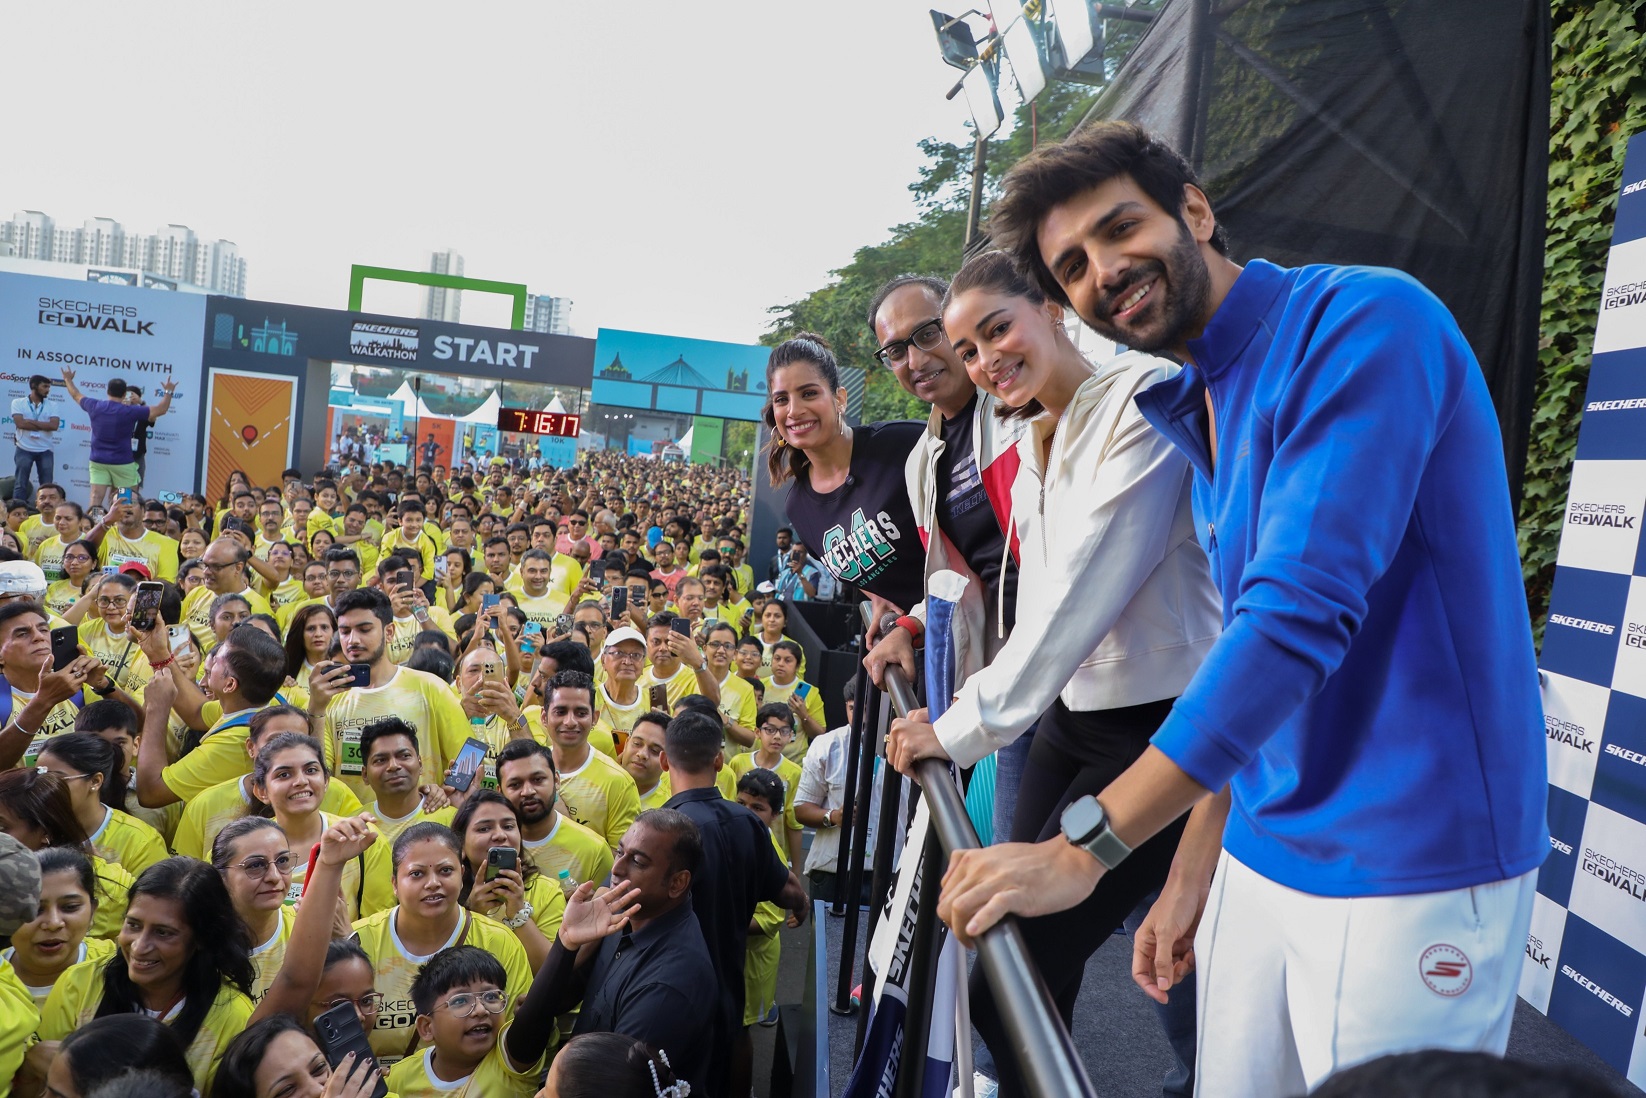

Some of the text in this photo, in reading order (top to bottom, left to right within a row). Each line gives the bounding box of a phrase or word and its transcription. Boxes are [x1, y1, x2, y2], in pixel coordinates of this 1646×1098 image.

[38, 297, 137, 318] SKECHERS
[38, 310, 157, 336] GOWALK
[352, 322, 419, 337] SKECHERS
[17, 348, 173, 374] IN ASSOCIATION WITH
[350, 345, 417, 361] WALKATHON
[432, 335, 540, 369] START
[0, 372, 30, 382] GoSport
[431, 422, 442, 430] 5K
[514, 411, 579, 436] 7:16:17
[1570, 502, 1626, 514] SKECHERS
[1568, 512, 1636, 529] GOWALK
[867, 555, 898, 582] ANGELES
[1549, 613, 1616, 635] SKECHERS
[1584, 847, 1646, 885] SKECHERS
[1561, 964, 1634, 1018] SKECHERS
